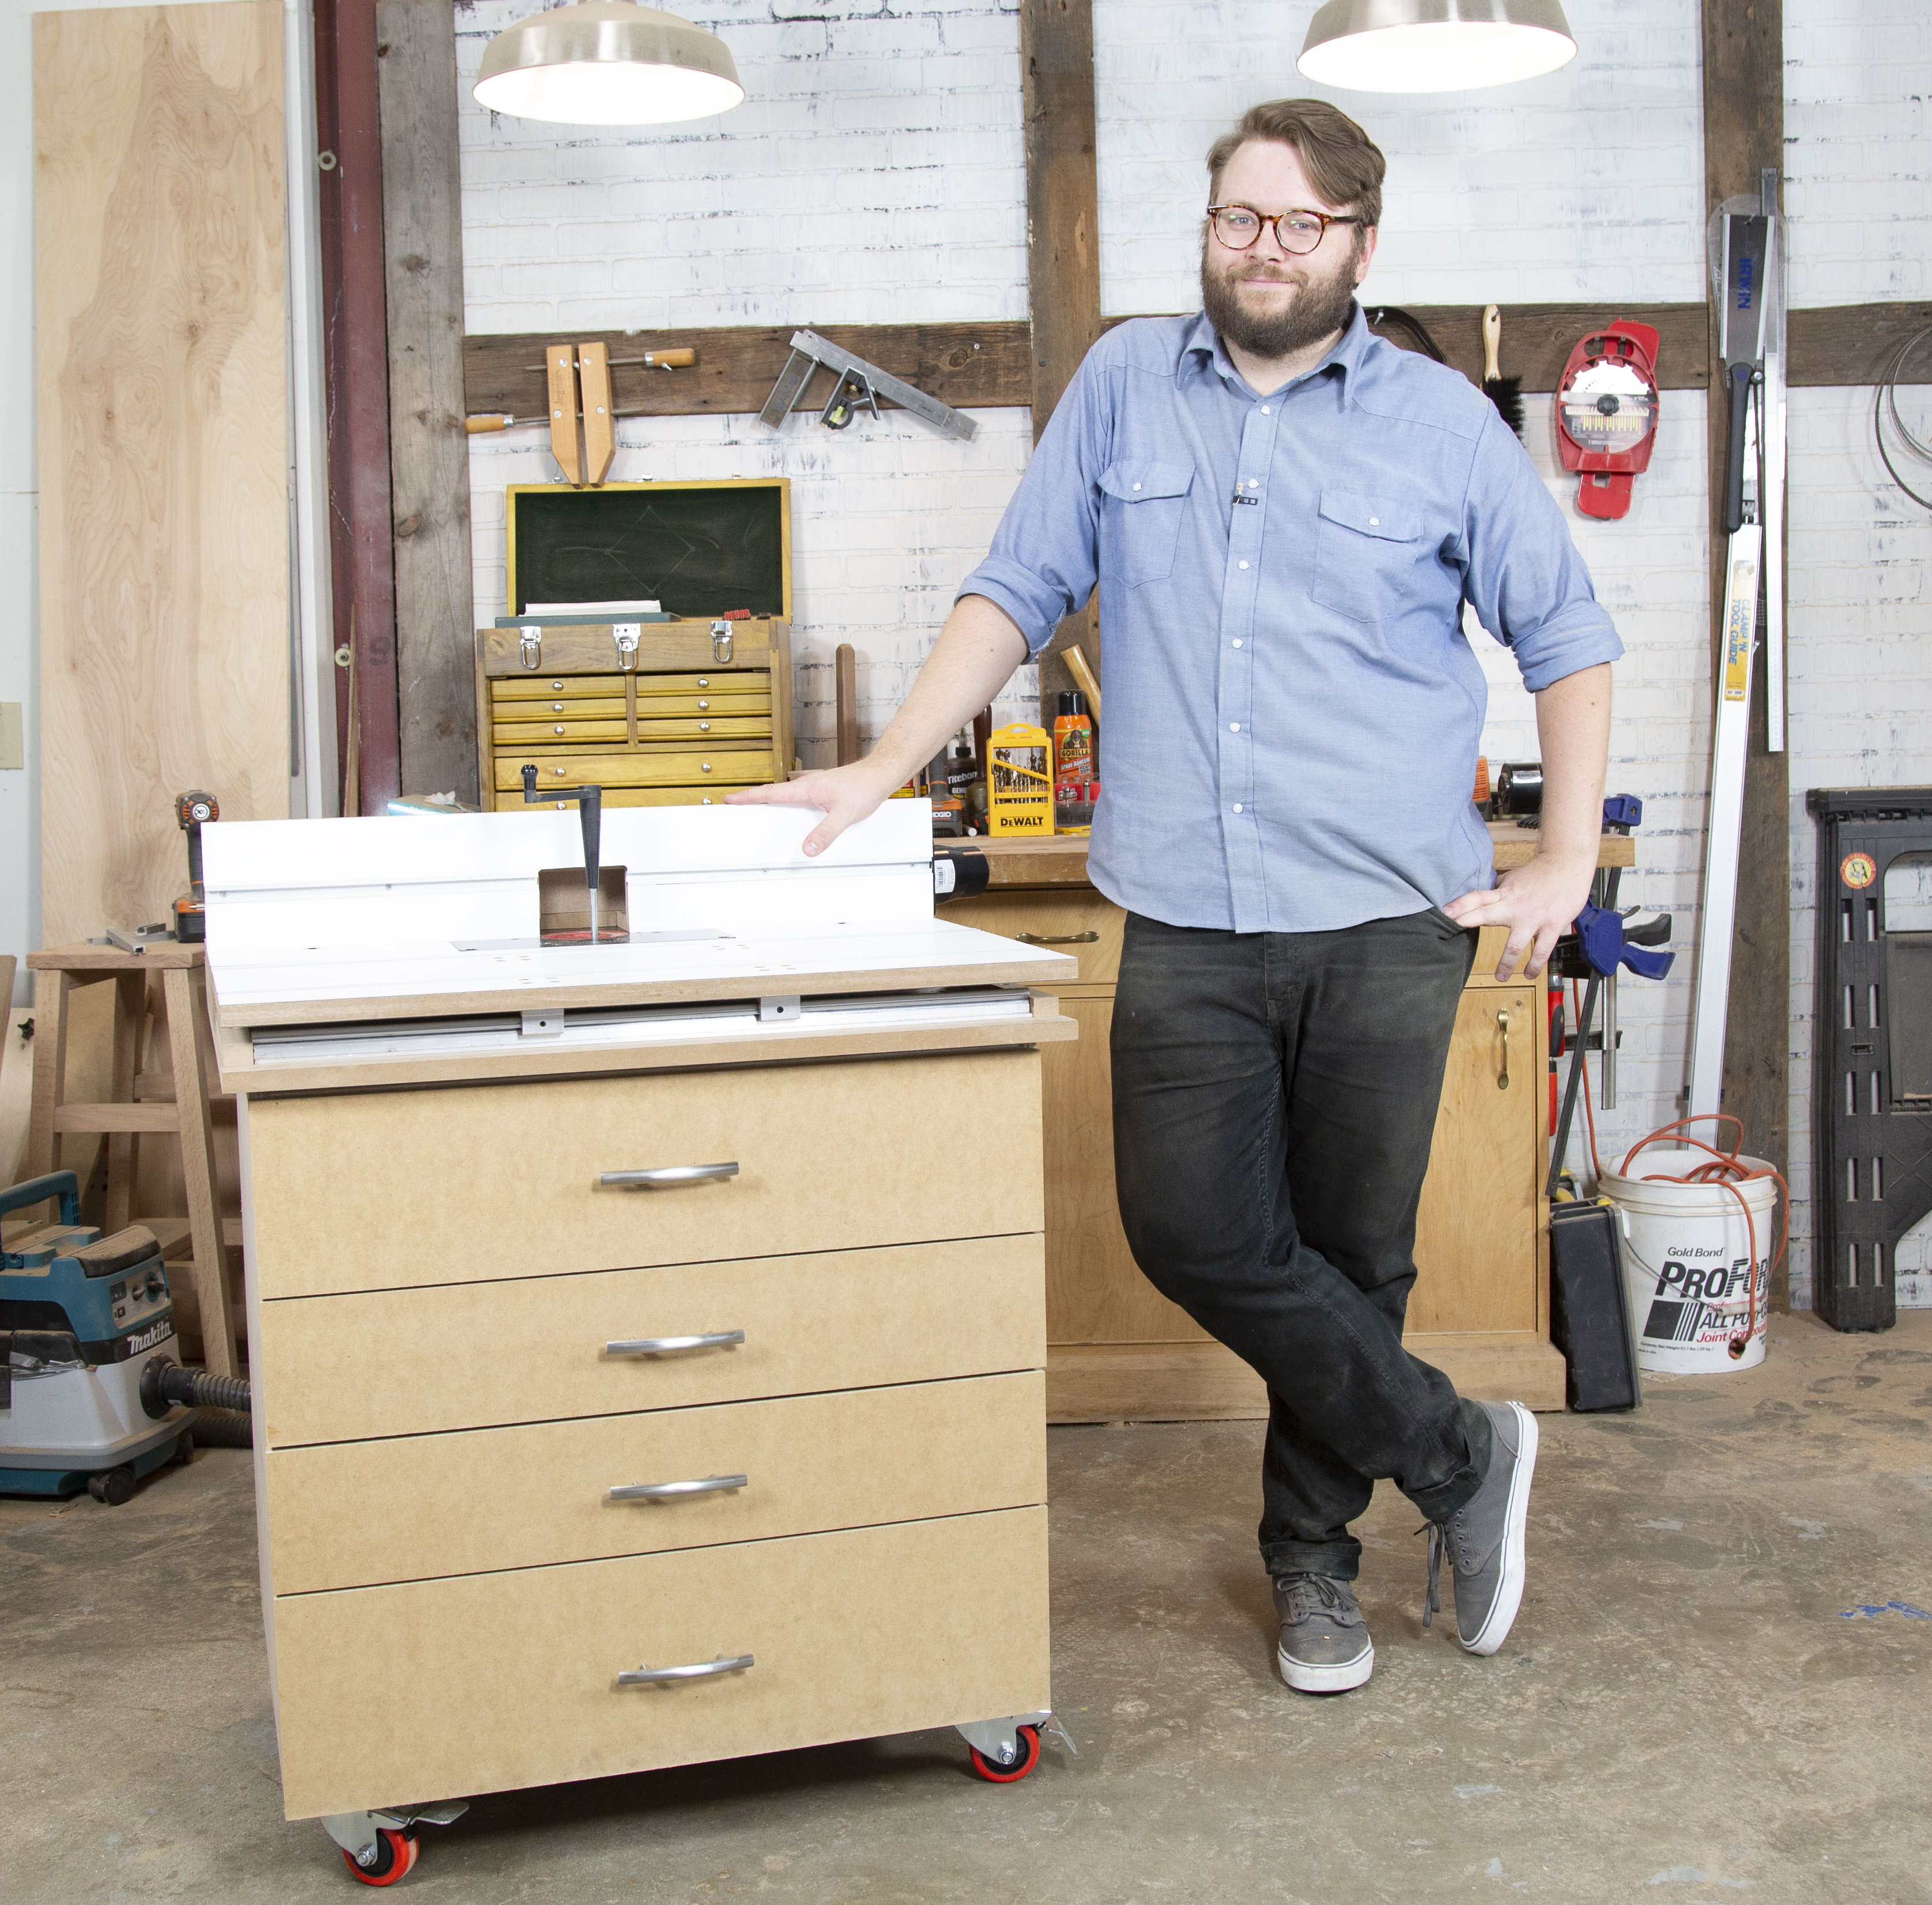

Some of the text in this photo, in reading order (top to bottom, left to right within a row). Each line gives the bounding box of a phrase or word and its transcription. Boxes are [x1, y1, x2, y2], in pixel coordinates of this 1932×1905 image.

[1737, 257, 1753, 310] IRWIN
[1739, 598, 1750, 638] CLAMP
[1729, 599, 1741, 666] TOOL GUIDE
[1062, 749, 1089, 757] GORILLA
[1667, 1247, 1724, 1257] Gold Bond
[1699, 1312, 1728, 1329] ALL
[1696, 1332, 1728, 1343] Joint
